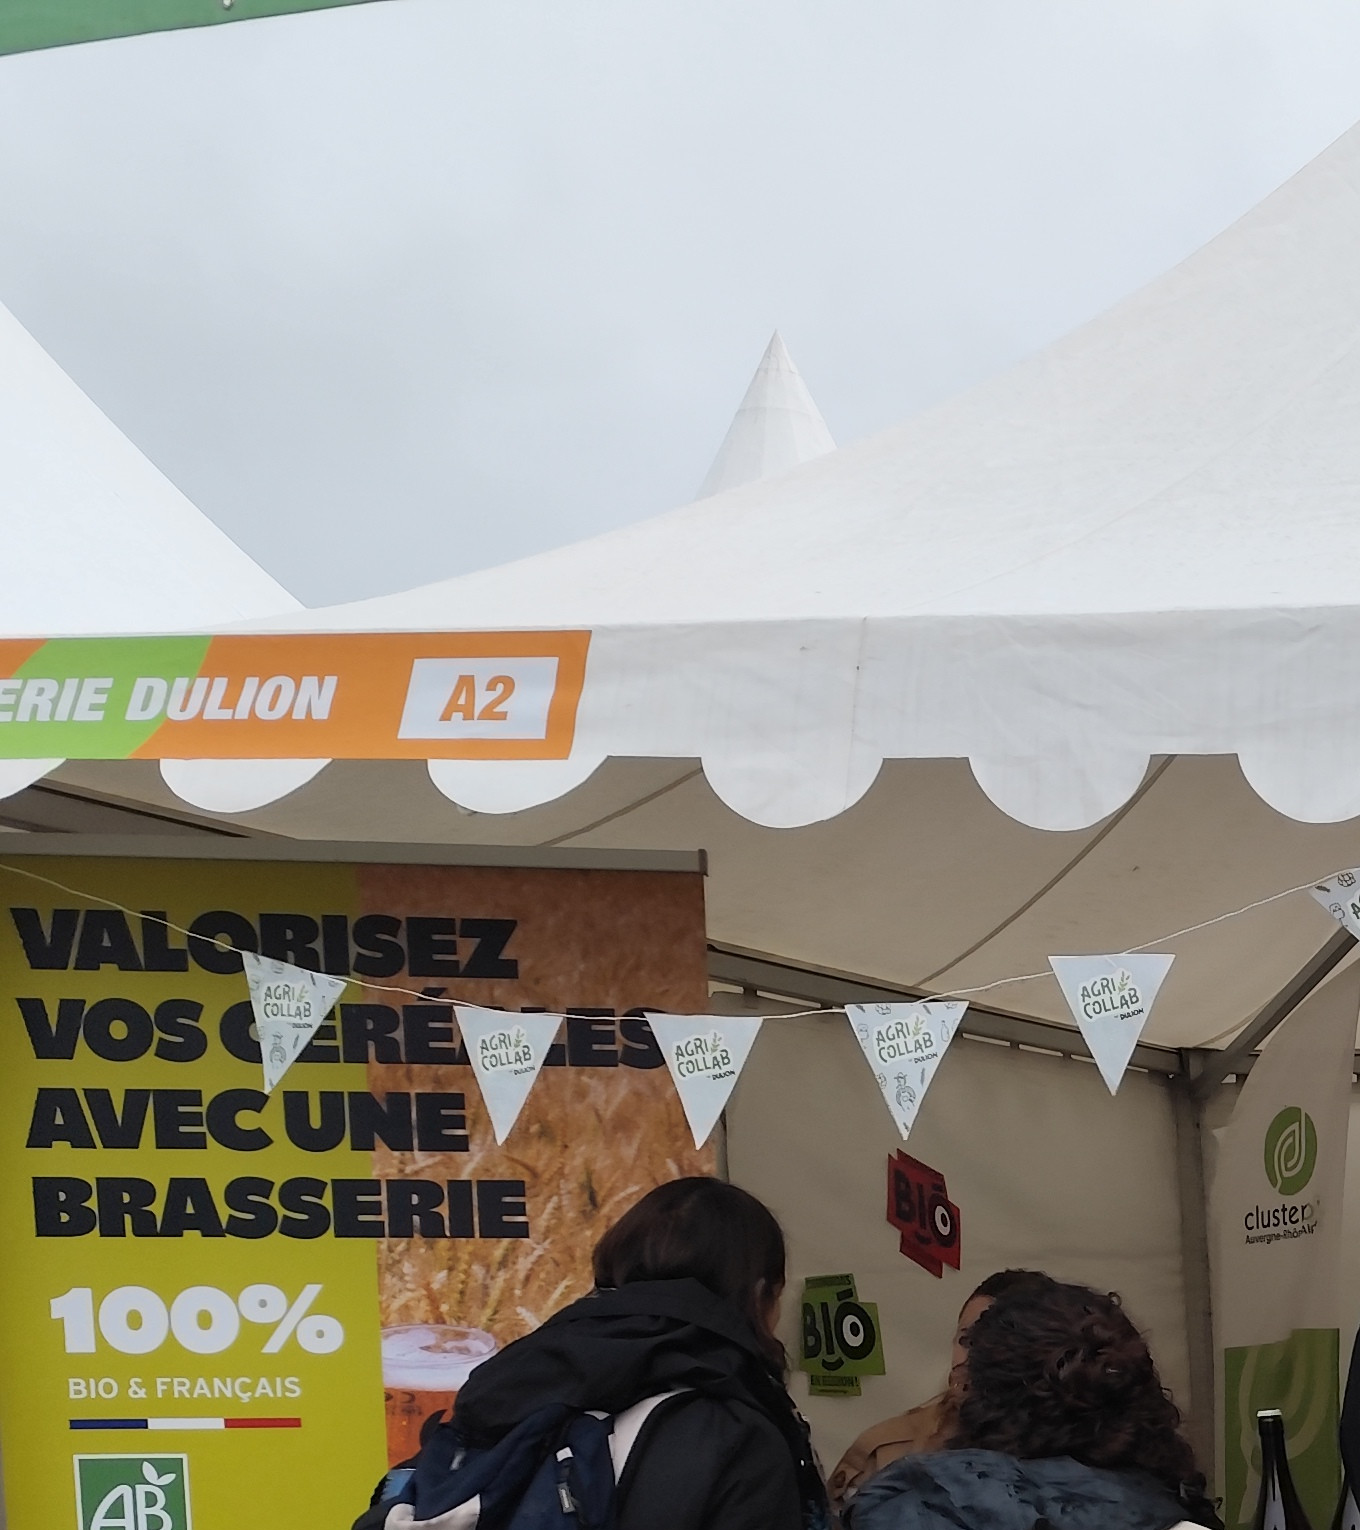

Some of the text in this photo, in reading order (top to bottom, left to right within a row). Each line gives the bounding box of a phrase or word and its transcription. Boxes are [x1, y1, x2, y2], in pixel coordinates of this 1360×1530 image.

[125, 675, 338, 721] DULION
[439, 674, 517, 722] A2
[10, 908, 519, 978] VALORISEZ
[1080, 976, 1117, 1003] AGRI
[1082, 988, 1140, 1019] COLLAB
[263, 1001, 312, 1018] COLLAB
[18, 998, 208, 1061] VOS
[479, 1031, 513, 1054] AGRI
[874, 1020, 911, 1048] AGRI
[481, 1045, 532, 1071] COLLAB
[674, 1039, 710, 1063] AGRI
[675, 1049, 732, 1077] COLLAB
[877, 1032, 934, 1063] COLLAB
[25, 1087, 470, 1152] AVEC UNE
[31, 1176, 530, 1239] BRASSERIE
[50, 1284, 344, 1354] 100%
[67, 1376, 302, 1403] BIO & FRANÇAIS
